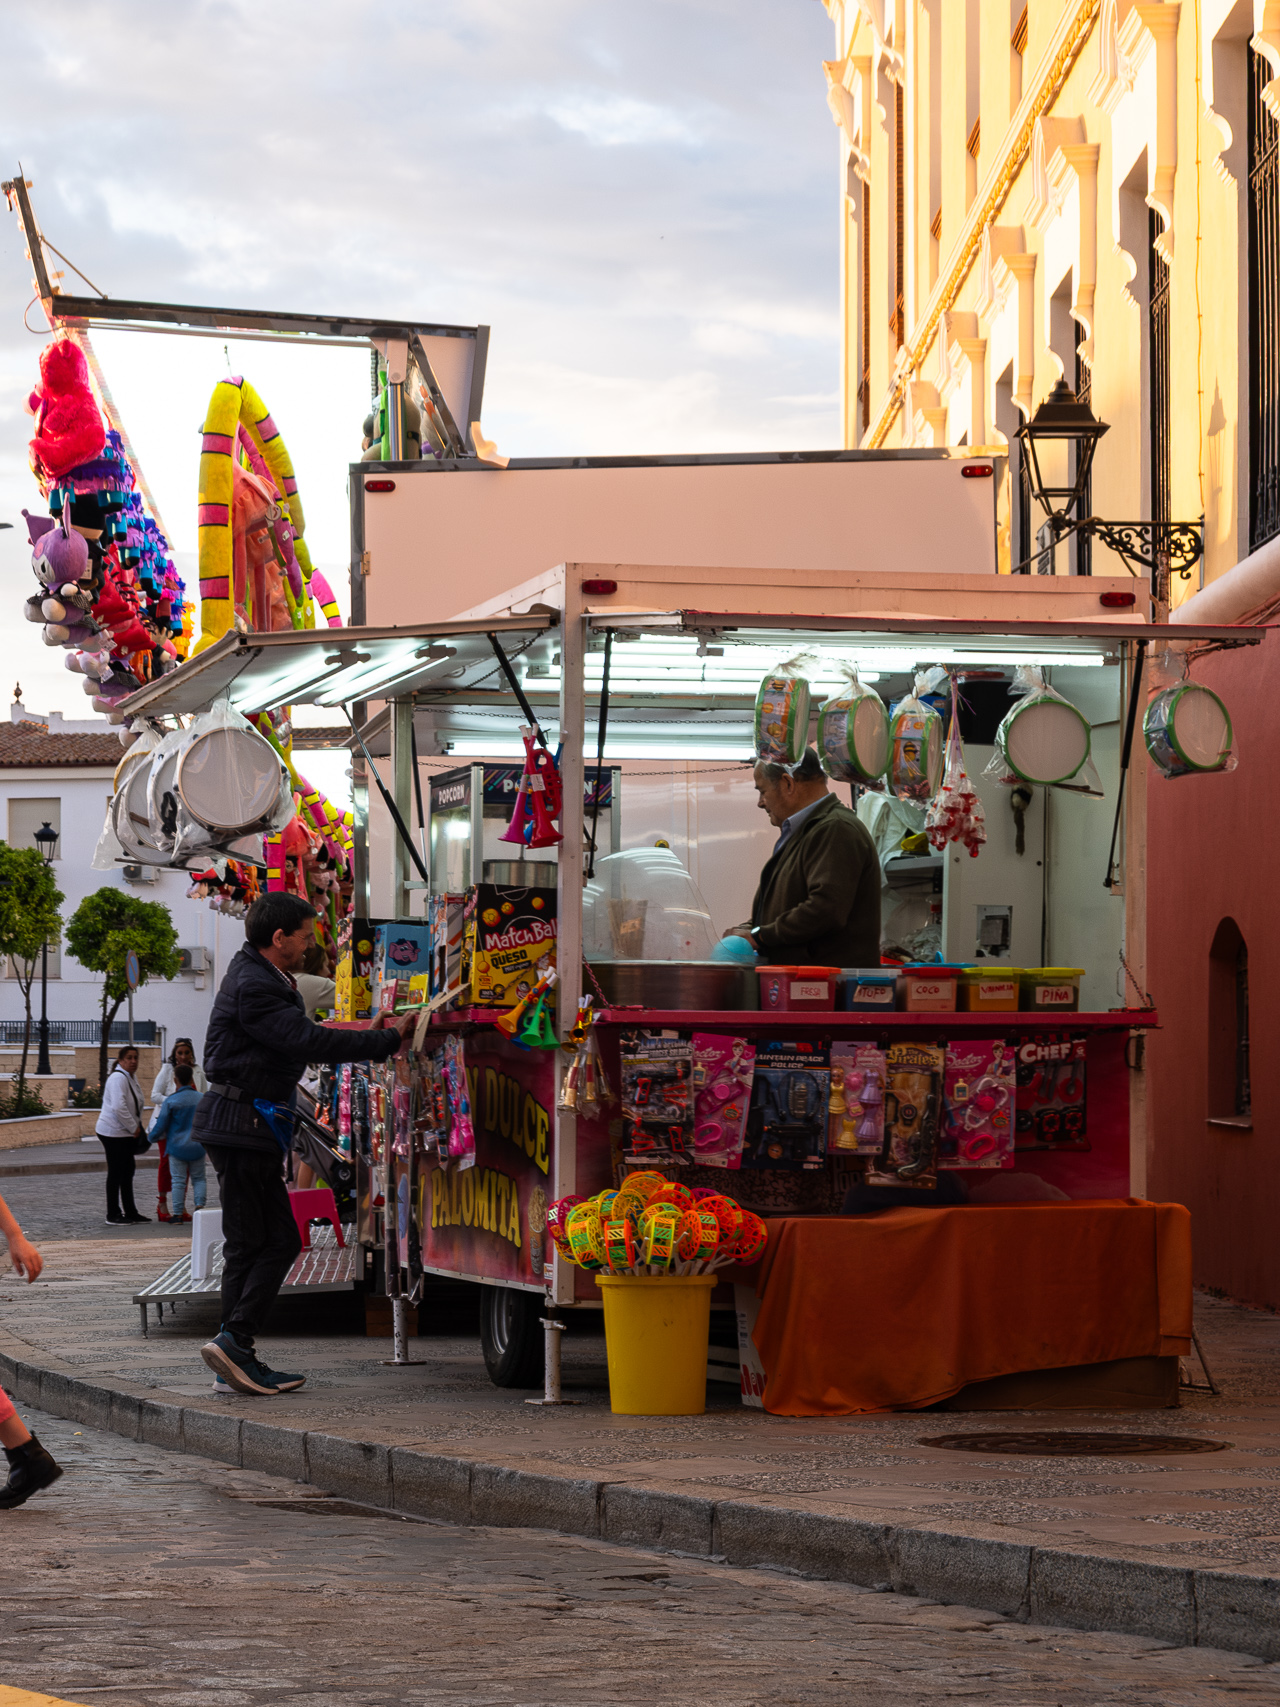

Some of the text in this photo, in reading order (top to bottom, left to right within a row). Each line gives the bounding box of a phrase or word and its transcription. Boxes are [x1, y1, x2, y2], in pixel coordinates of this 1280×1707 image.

[438, 784, 465, 805] POPCORN
[490, 949, 527, 969] QUESO
[915, 985, 940, 995] COCO
[1042, 988, 1069, 1003] PIÑA
[693, 1046, 721, 1059] octor
[795, 1055, 825, 1063] PEACE
[887, 1046, 939, 1067] Pirates
[1020, 1042, 1071, 1063] CHEF
[770, 1061, 804, 1069] POLICE
[485, 1066, 549, 1176] DULCE
[431, 1165, 520, 1248] PALOMITA
